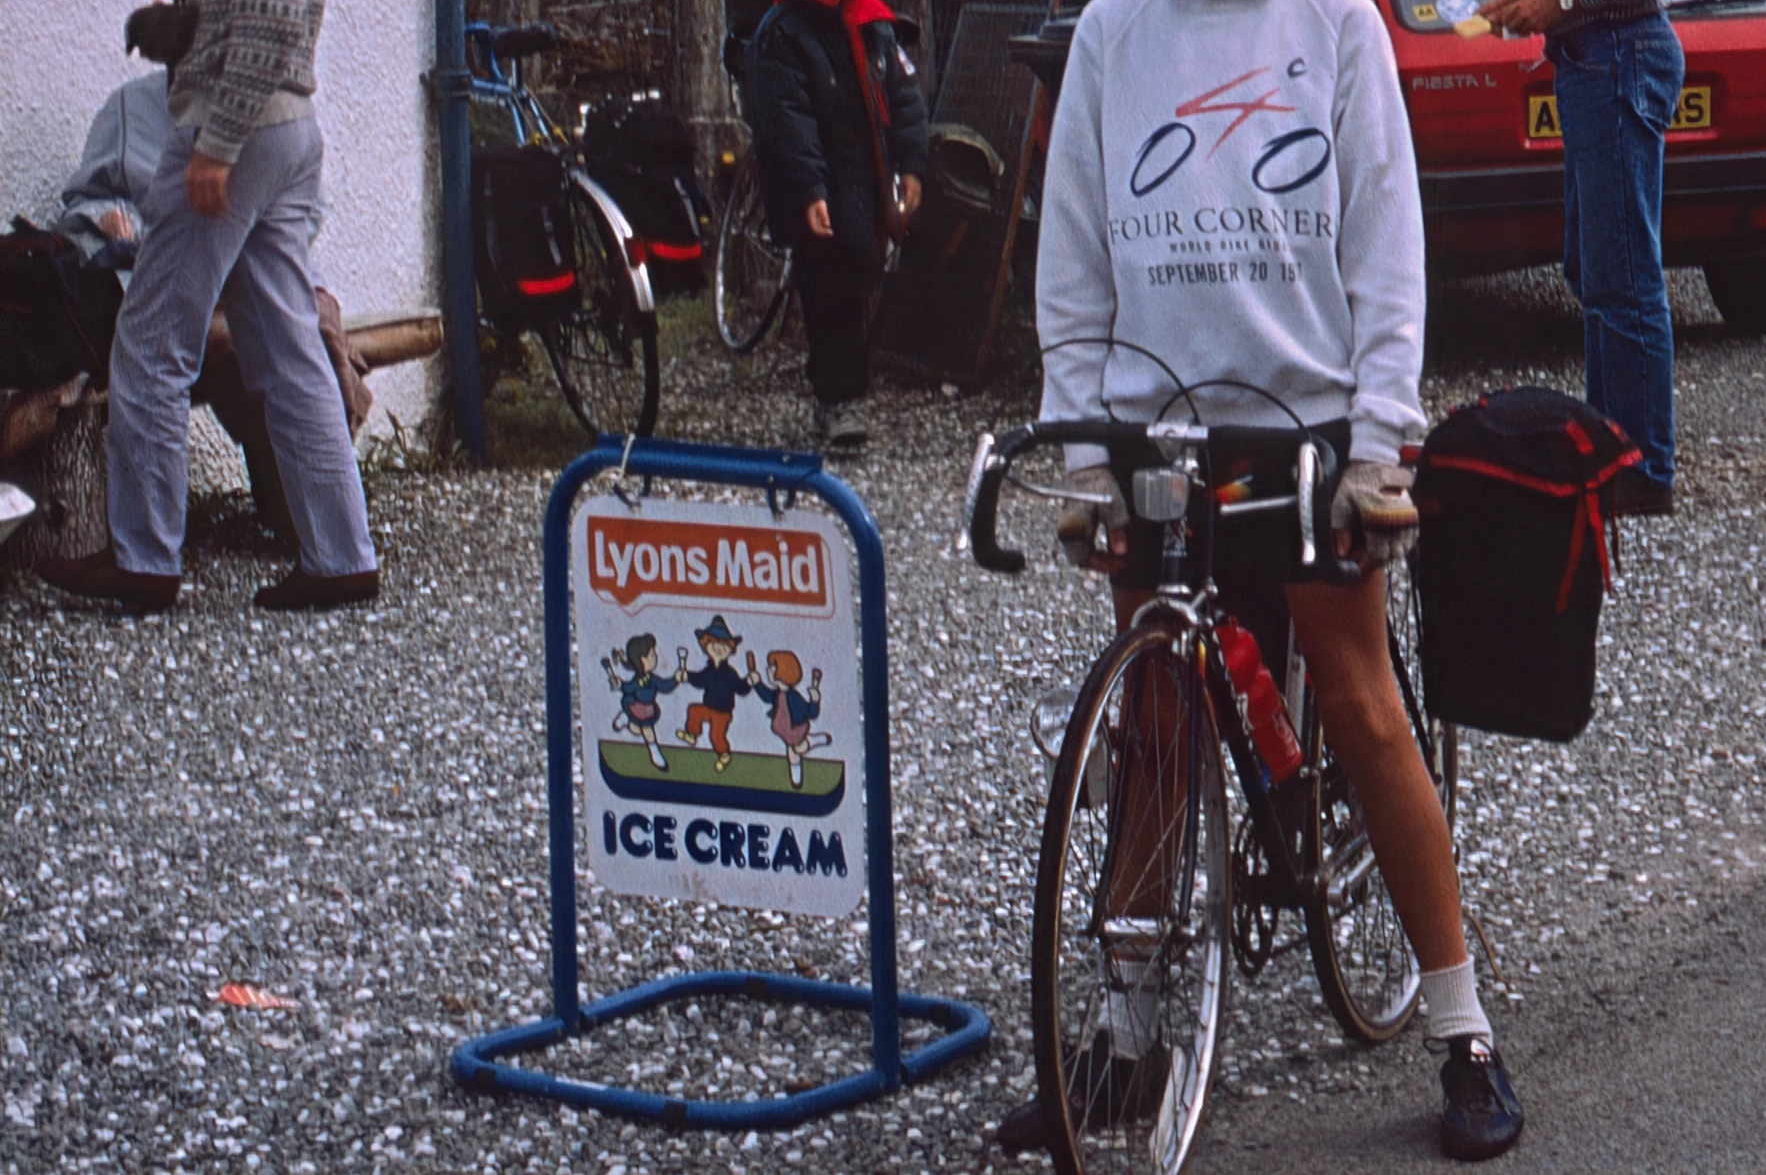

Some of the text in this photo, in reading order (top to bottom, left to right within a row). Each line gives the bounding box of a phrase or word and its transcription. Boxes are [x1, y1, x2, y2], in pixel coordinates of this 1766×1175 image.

[1412, 73, 1497, 91] FIESTA L
[1108, 206, 1333, 245] FOUR CORNER
[1148, 261, 1240, 286] SEPTEMBER
[1249, 261, 1268, 283] 20
[594, 529, 821, 594] Lyons Maid
[602, 809, 849, 878] ICE CREAM
